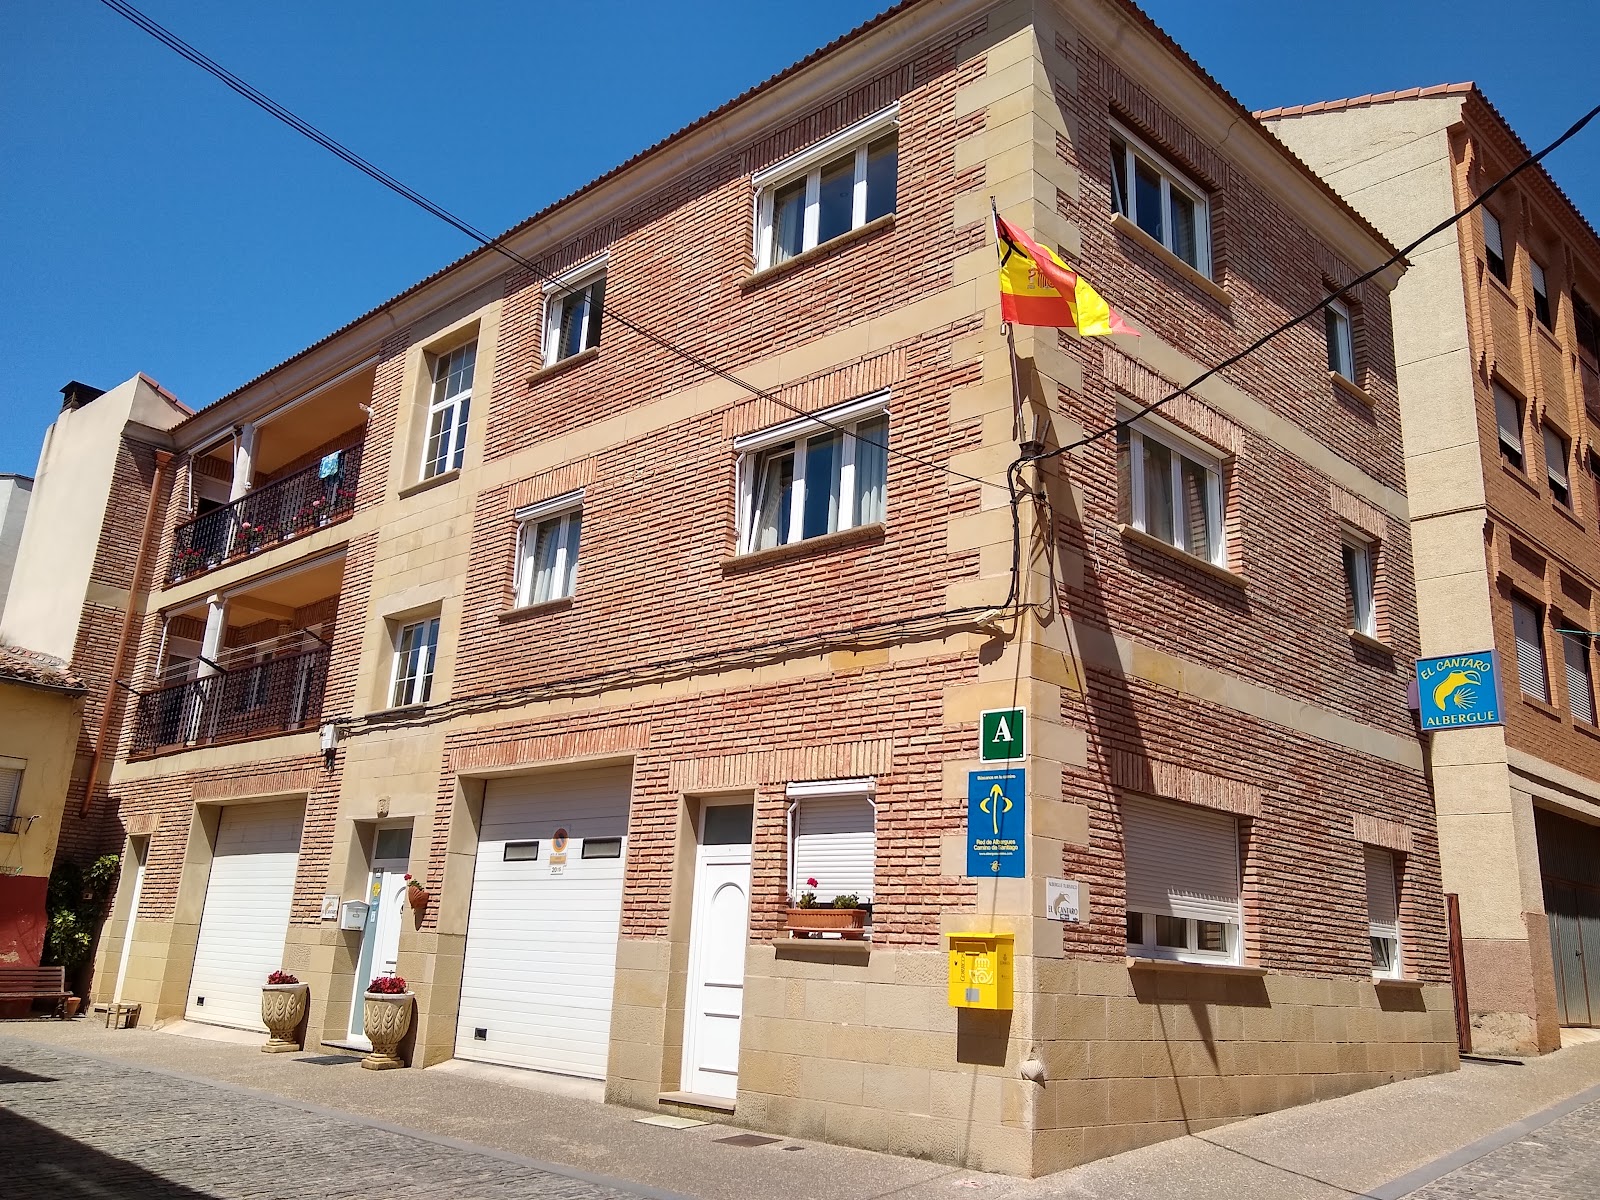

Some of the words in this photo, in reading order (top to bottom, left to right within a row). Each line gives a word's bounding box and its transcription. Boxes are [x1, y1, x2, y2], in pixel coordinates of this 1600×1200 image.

[1421, 667, 1435, 680] EL
[1436, 657, 1491, 672] CANTARO
[1426, 710, 1495, 726] ALBERGUE
[991, 715, 1014, 743] A
[1048, 905, 1053, 913] EL
[1058, 906, 1078, 916] CANTARO
